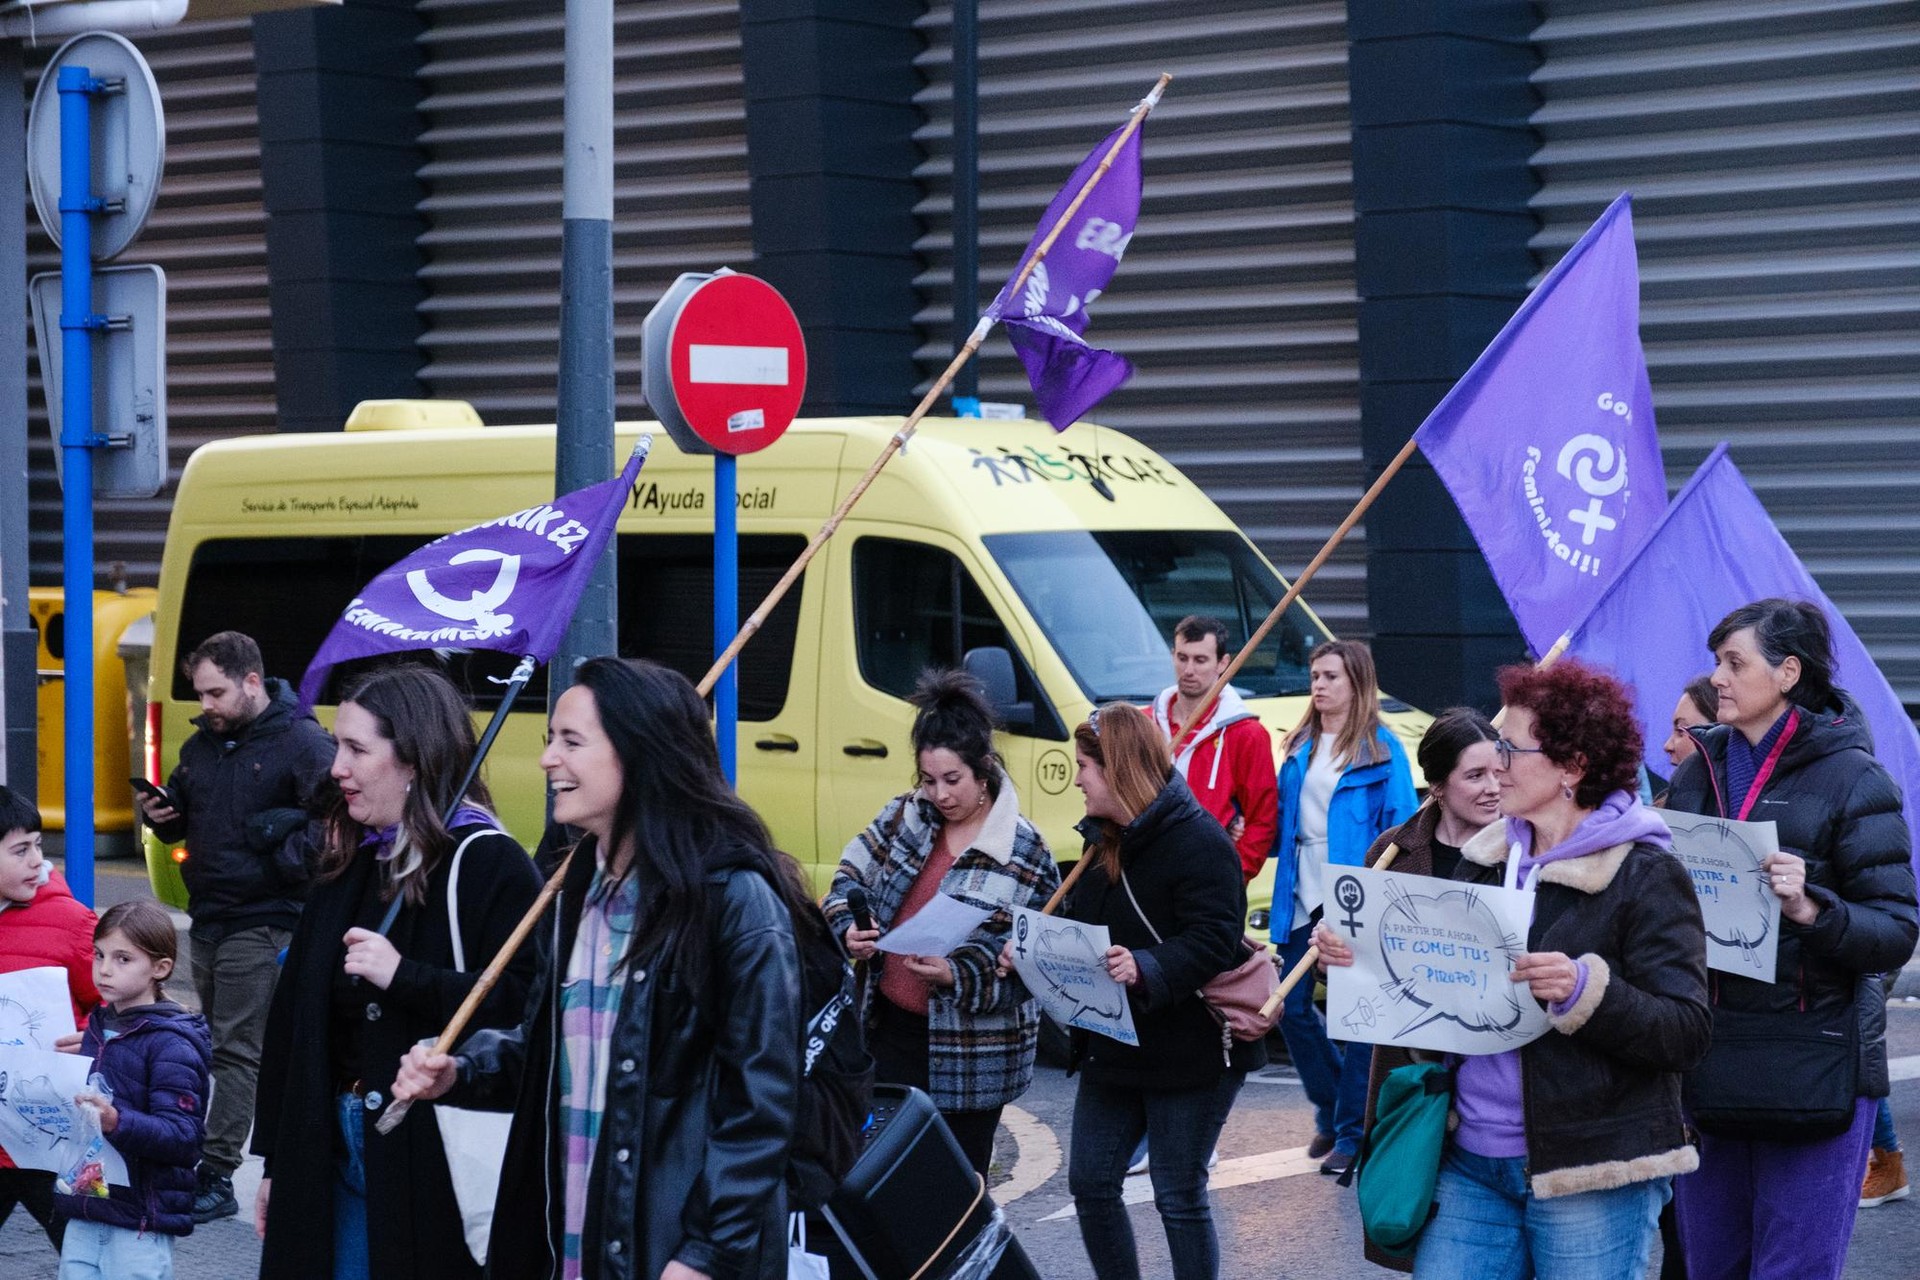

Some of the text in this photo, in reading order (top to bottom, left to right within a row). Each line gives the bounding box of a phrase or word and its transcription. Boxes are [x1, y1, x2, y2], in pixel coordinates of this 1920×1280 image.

[289, 497, 335, 514] Transporte
[1043, 763, 1066, 780] 179
[1384, 923, 1391, 932] A
[1393, 924, 1430, 936] PARTIR
[1431, 928, 1445, 937] DE
[1459, 946, 1490, 963] TUS
